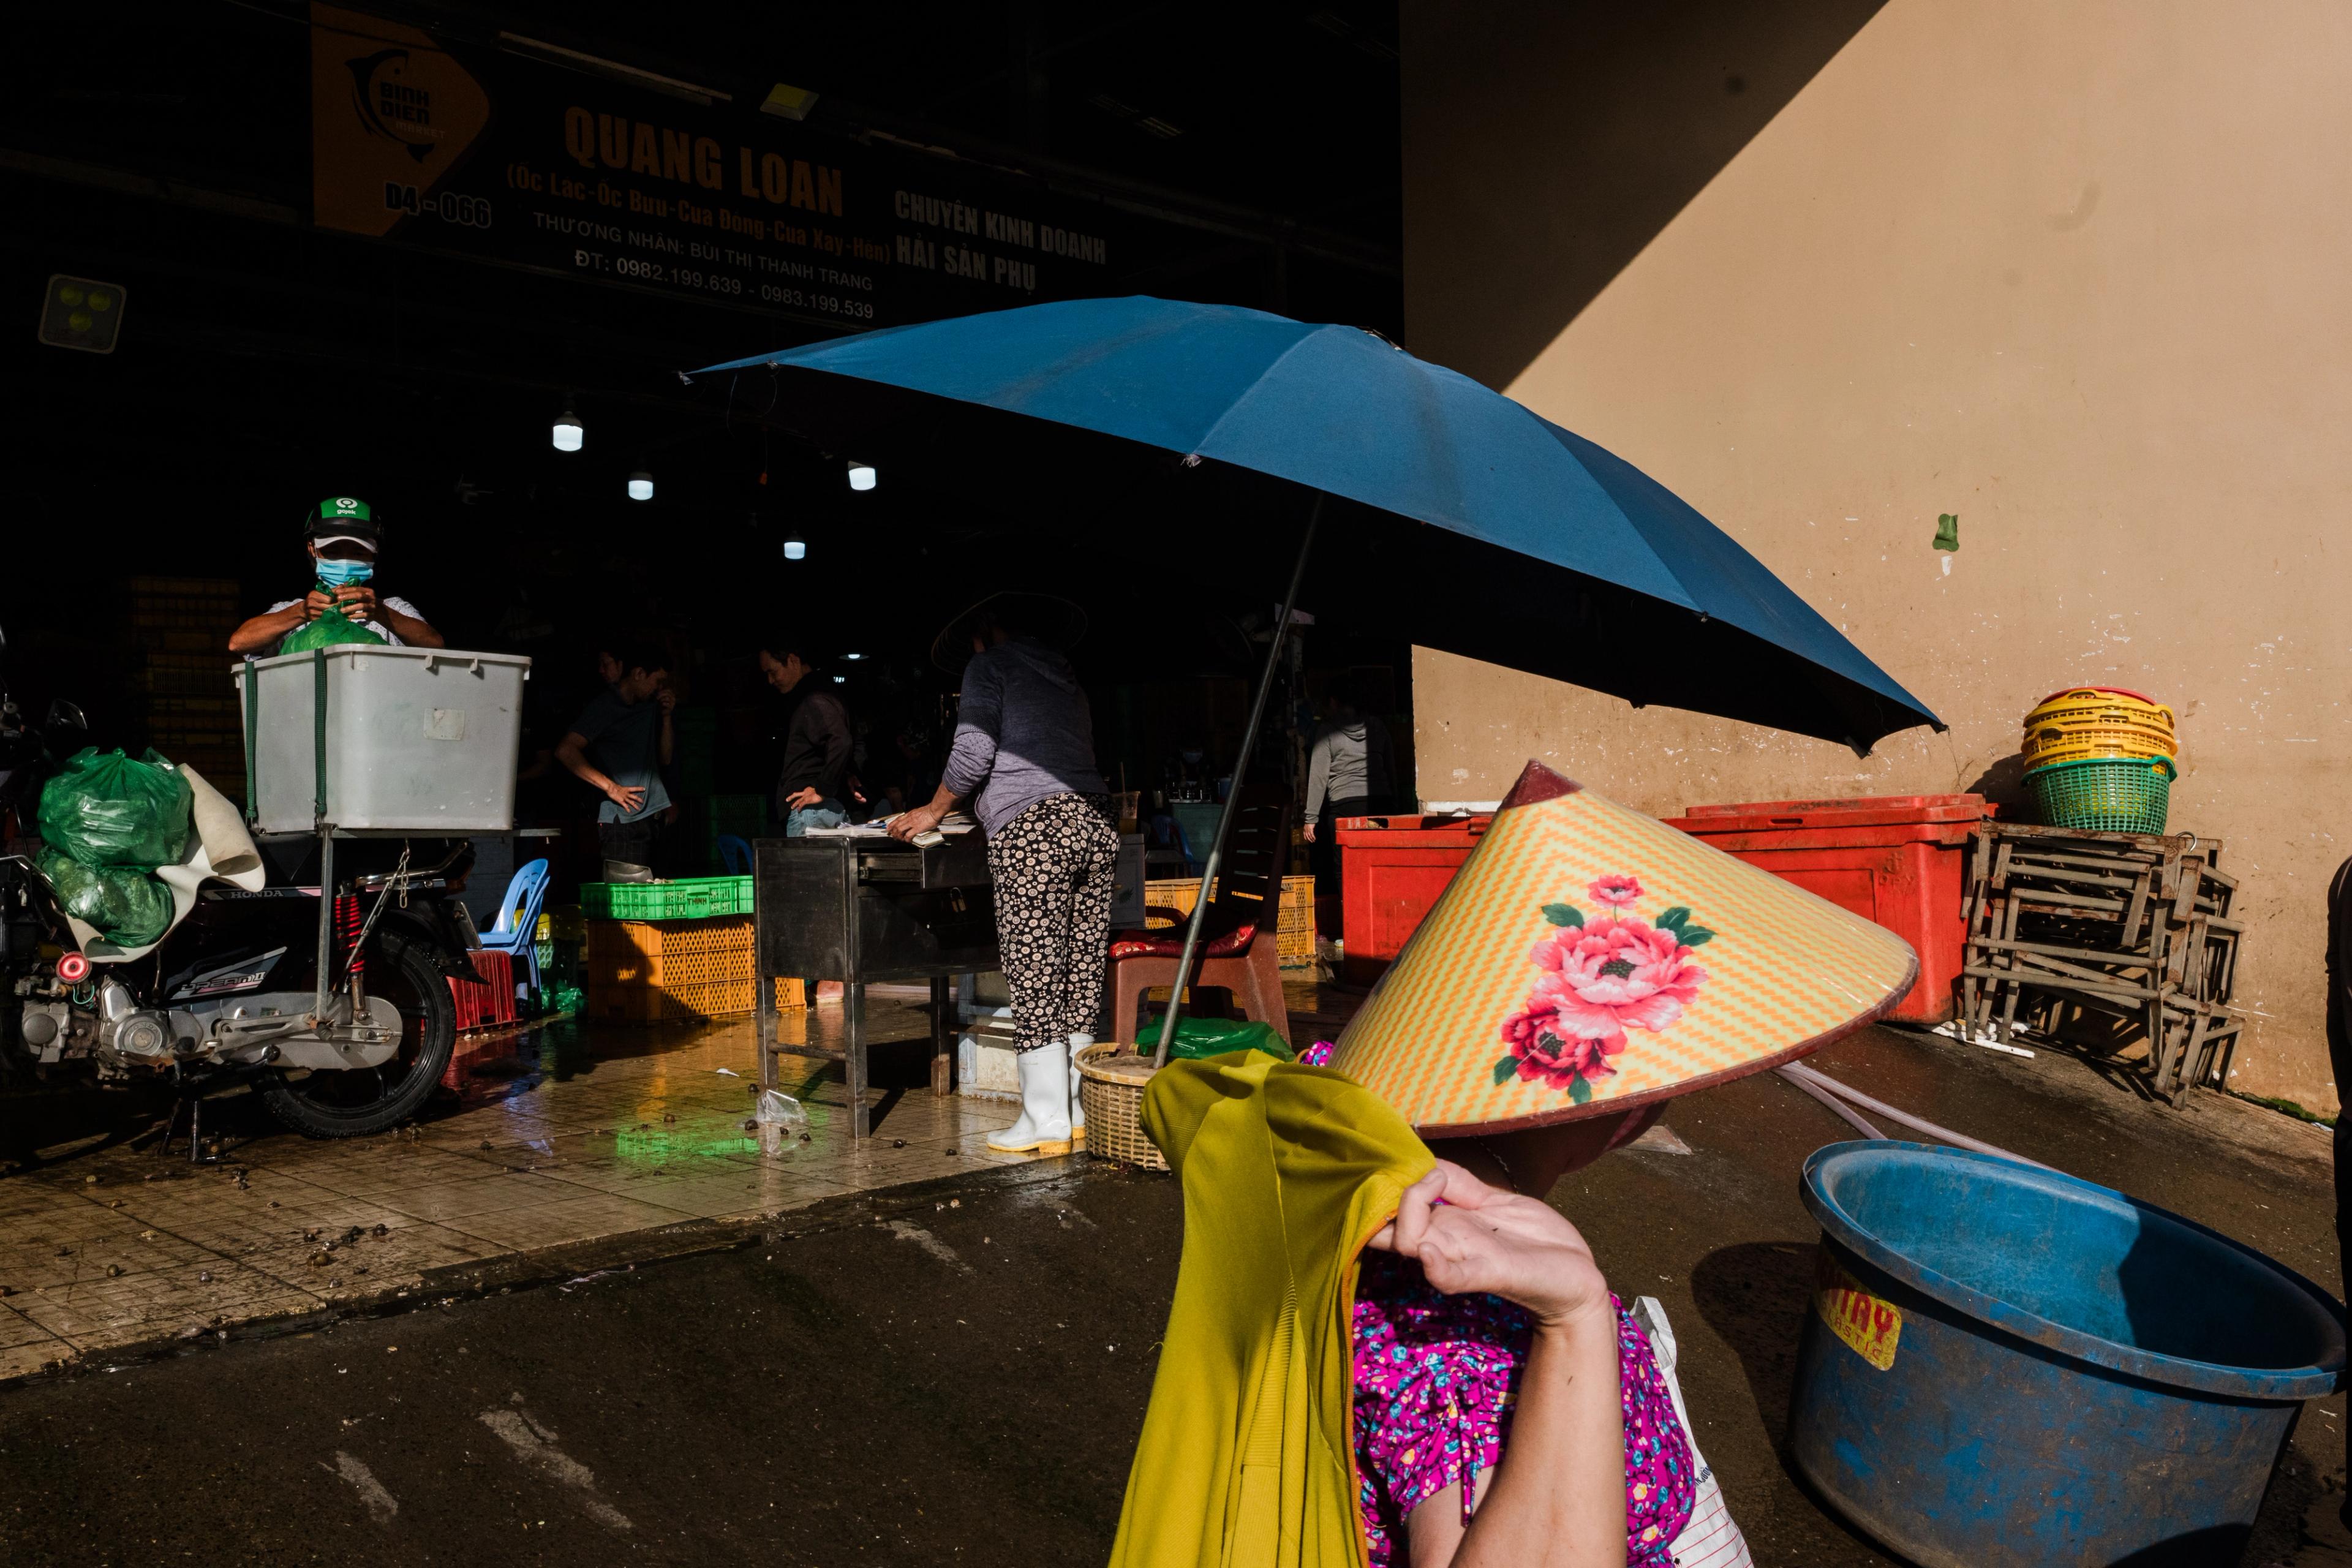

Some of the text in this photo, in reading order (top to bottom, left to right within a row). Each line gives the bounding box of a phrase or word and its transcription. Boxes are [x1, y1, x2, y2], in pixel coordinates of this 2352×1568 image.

[564, 105, 844, 217] QUANG LOAN
[533, 211, 873, 291] THƯƠNG NHÂN: BÙI THỊ THANH TRANG
[894, 189, 1107, 265] CHUYÊN KINH DOANH
[574, 249, 610, 272] ĐT:
[616, 257, 742, 295] 0982.199.639
[761, 284, 874, 319] 0983.199.539
[895, 232, 1037, 296] HẢI SẢN PHỤ
[230, 890, 284, 899] HONDA
[181, 974, 255, 991] DREAM
